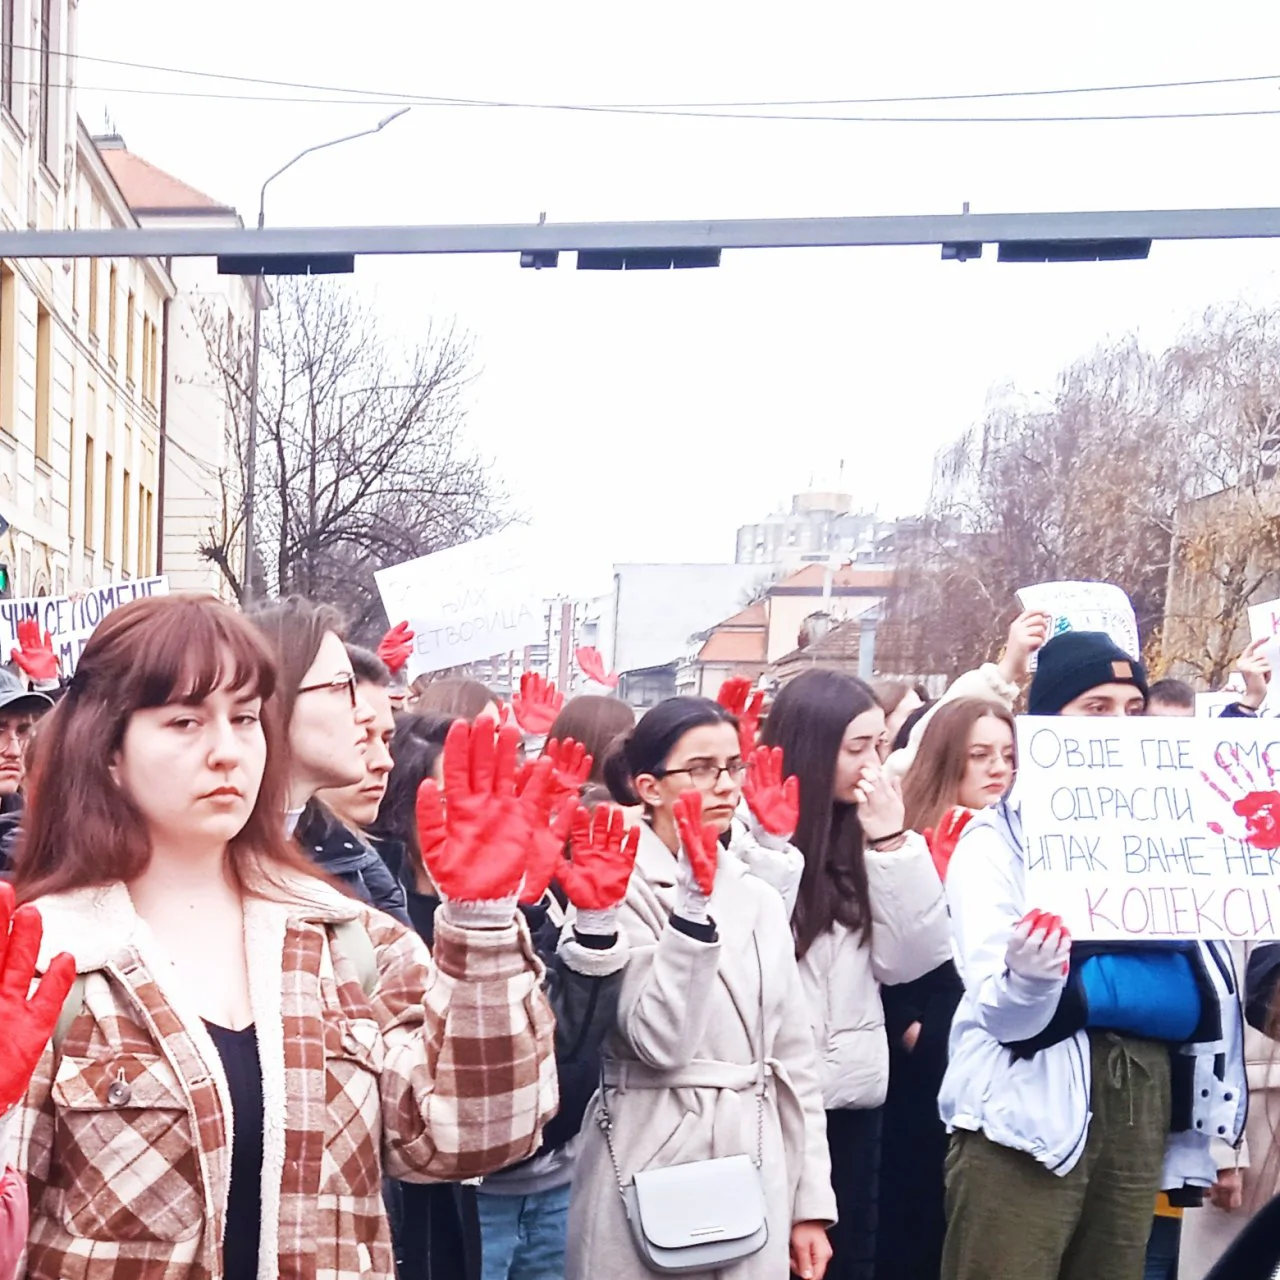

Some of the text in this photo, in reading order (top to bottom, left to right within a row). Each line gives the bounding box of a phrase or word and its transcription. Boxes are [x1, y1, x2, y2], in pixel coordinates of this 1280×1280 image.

[416, 602, 533, 655] ЕТВОРИЦА
[1030, 728, 1124, 769] ОВДЕ
[1141, 739, 1194, 770] ГДЕ
[1051, 786, 1194, 823] ОДРАСЛИ
[1027, 834, 1108, 871] ИПАК
[1085, 886, 1275, 937] КОДЕКСИ
